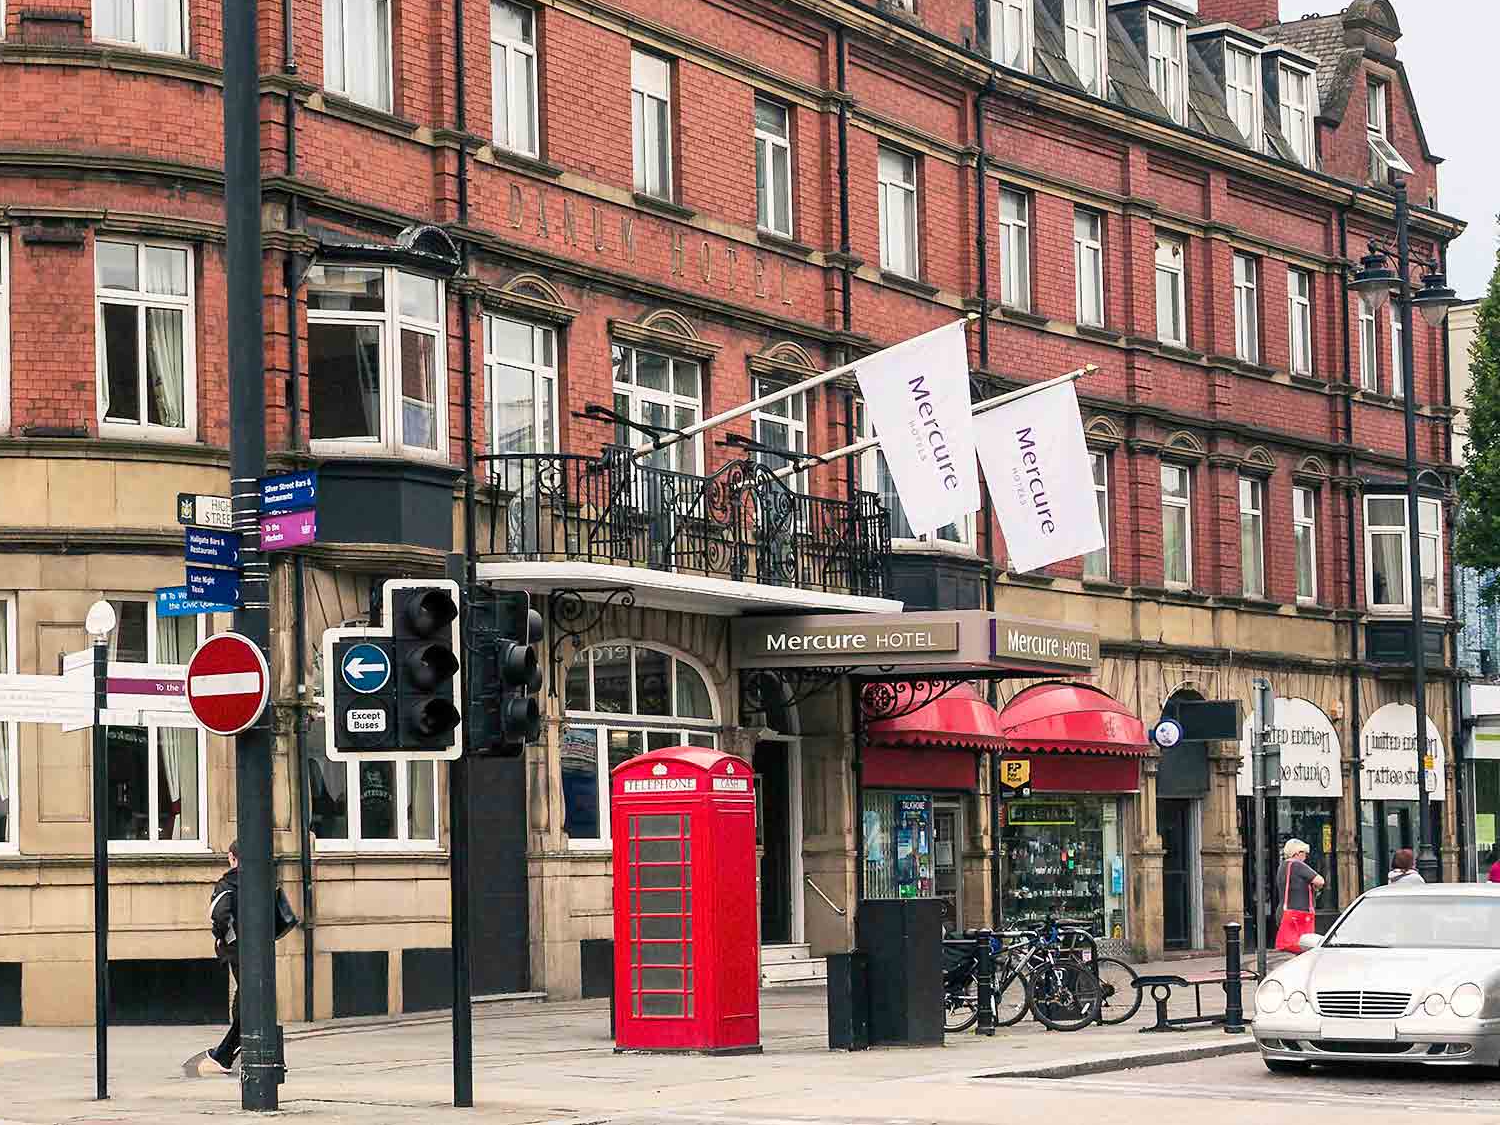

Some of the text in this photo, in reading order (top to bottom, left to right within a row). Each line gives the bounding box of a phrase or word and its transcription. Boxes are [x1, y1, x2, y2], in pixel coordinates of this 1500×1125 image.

[506, 182, 794, 306] DANUM HOTEL
[908, 375, 959, 492] Mercure
[279, 482, 295, 490] Street
[1015, 426, 1056, 536] Mercure
[264, 493, 293, 504] Restaurants
[204, 511, 232, 525] STREE
[190, 545, 218, 556] Restaurants
[191, 574, 215, 585] Late Night
[168, 602, 180, 611] the
[766, 631, 937, 651] Mercure HOTEL
[1007, 628, 1093, 661] Mercure HOTEL
[155, 683, 164, 692] To
[166, 683, 180, 692] the
[351, 711, 381, 722] Except
[353, 721, 380, 730] Buses
[626, 777, 695, 791] TELEPHONE
